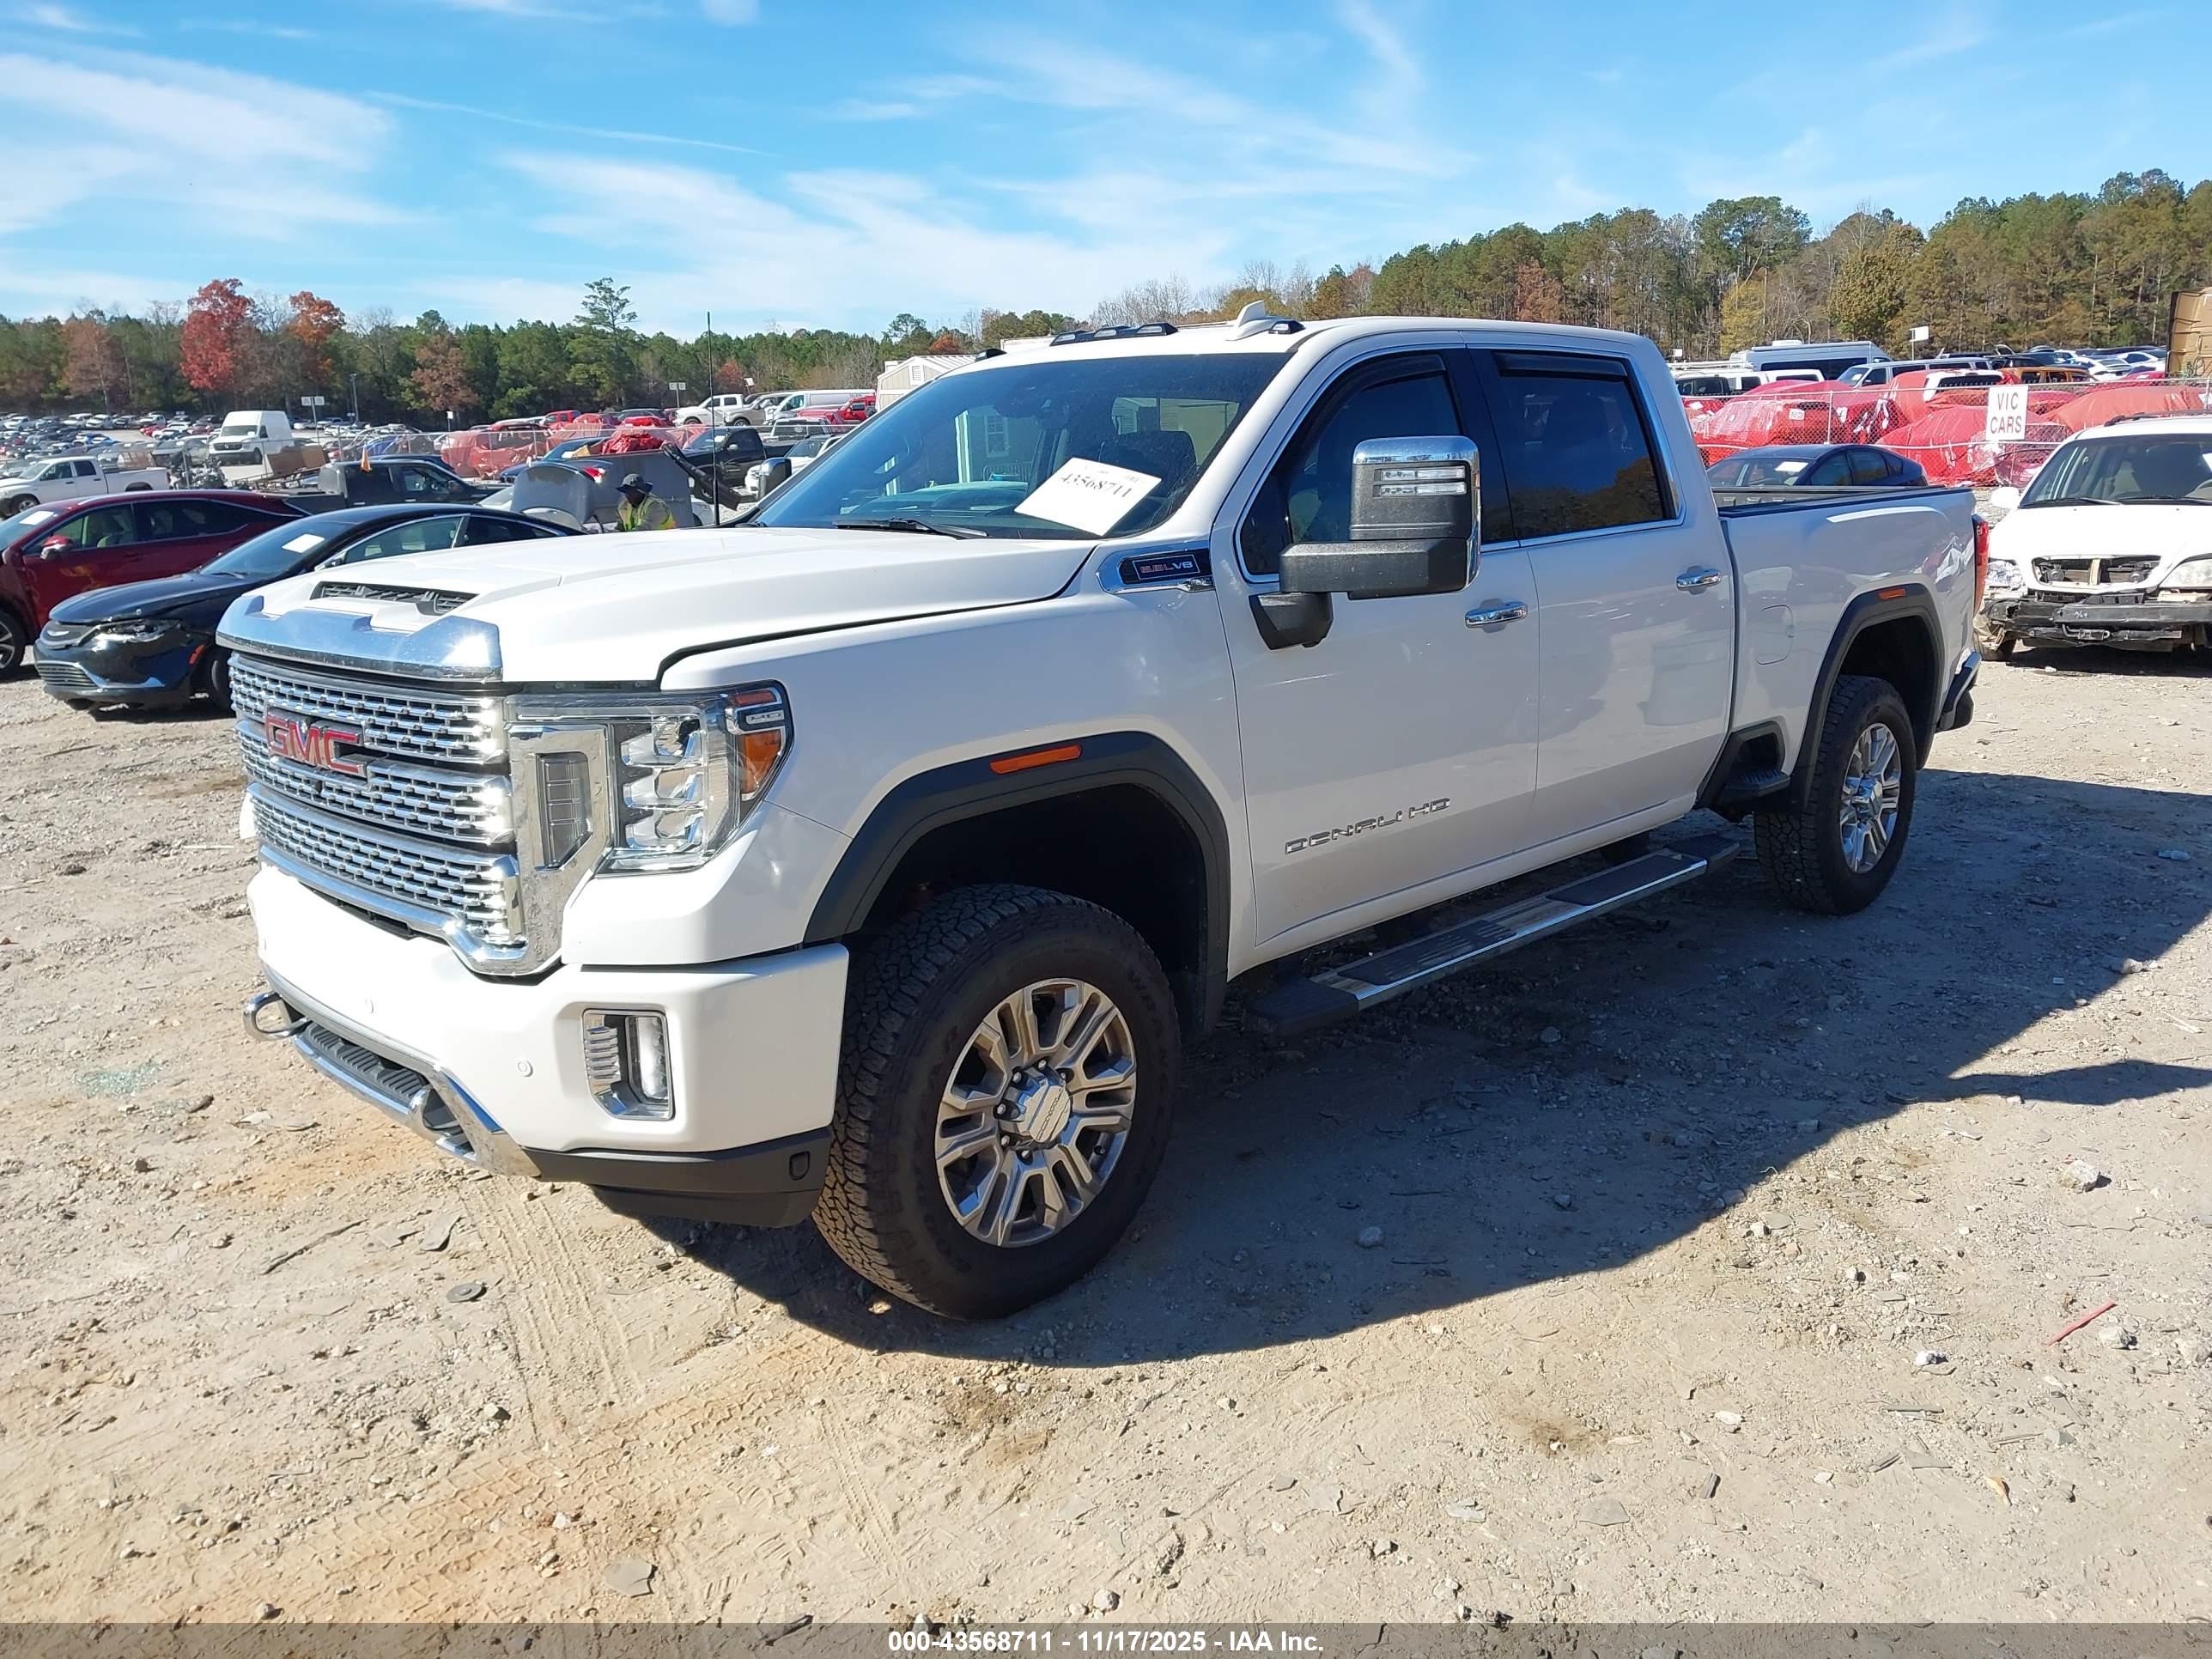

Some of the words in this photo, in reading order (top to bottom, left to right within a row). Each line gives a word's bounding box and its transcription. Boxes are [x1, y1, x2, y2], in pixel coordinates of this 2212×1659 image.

[1997, 392, 2019, 410] VIC
[1990, 416, 2022, 434] CARS
[264, 714, 362, 775] GMC
[1285, 811, 1403, 854] DENALI
[1408, 798, 1450, 818] HD
